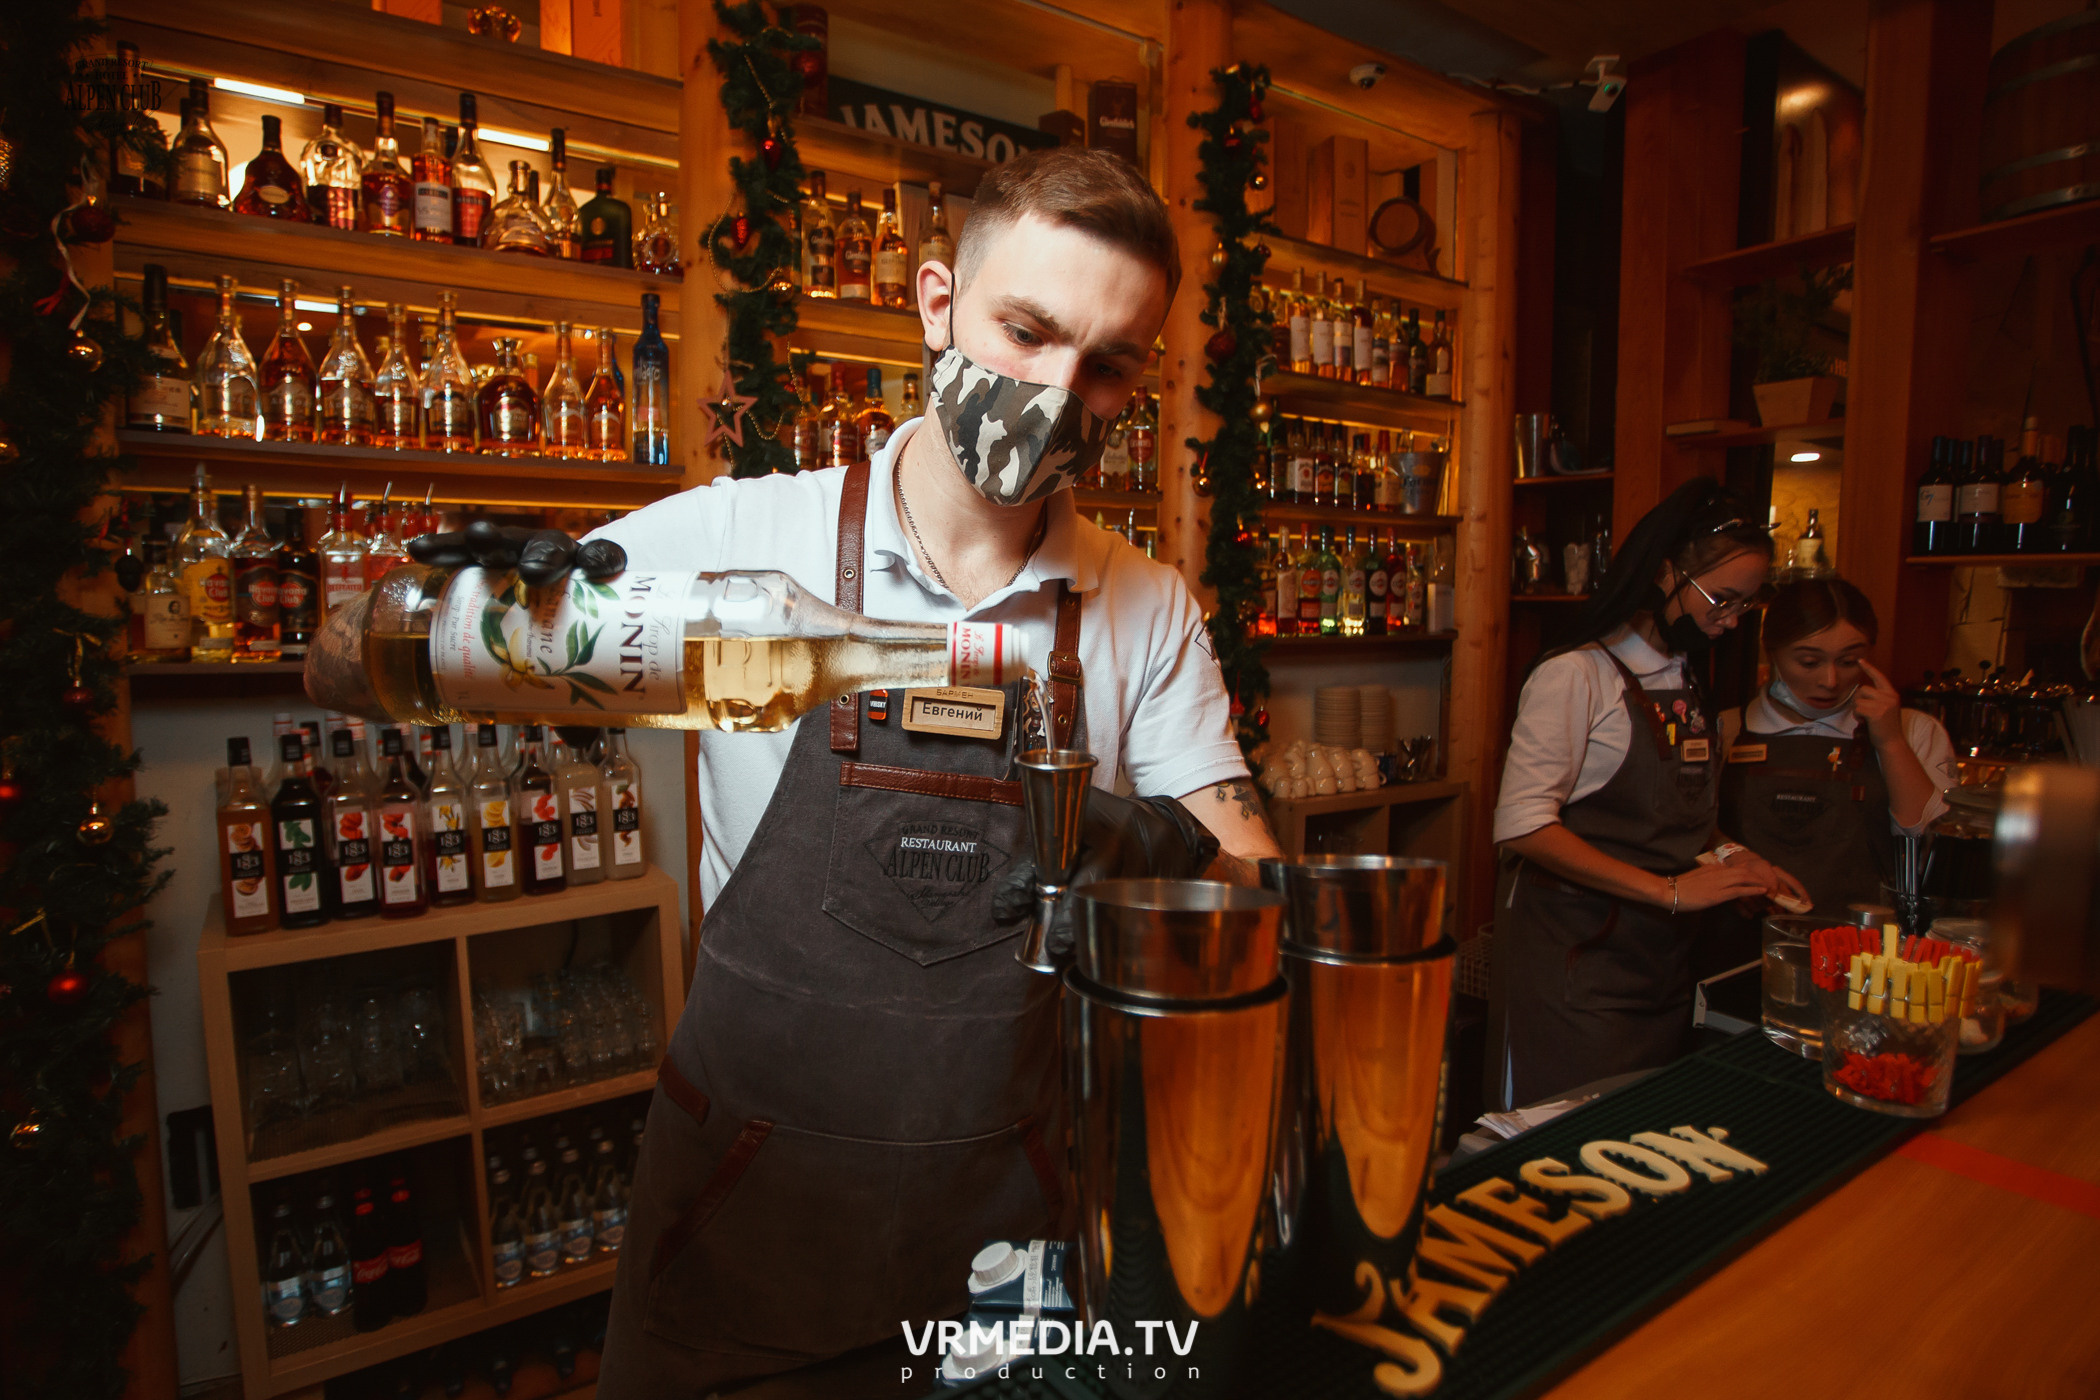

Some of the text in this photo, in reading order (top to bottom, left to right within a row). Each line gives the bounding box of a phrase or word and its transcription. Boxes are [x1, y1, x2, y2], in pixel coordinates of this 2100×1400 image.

[840, 103, 1028, 165] JAMESO
[464, 590, 481, 629] tradition
[463, 632, 474, 644] de
[619, 576, 656, 694] MONIN
[960, 627, 971, 679] MONIN
[922, 702, 983, 721] Евгений
[884, 846, 991, 883] ALPEN CLUB
[900, 837, 977, 853] RESTAURANT
[1310, 1125, 1768, 1398] JAMESON
